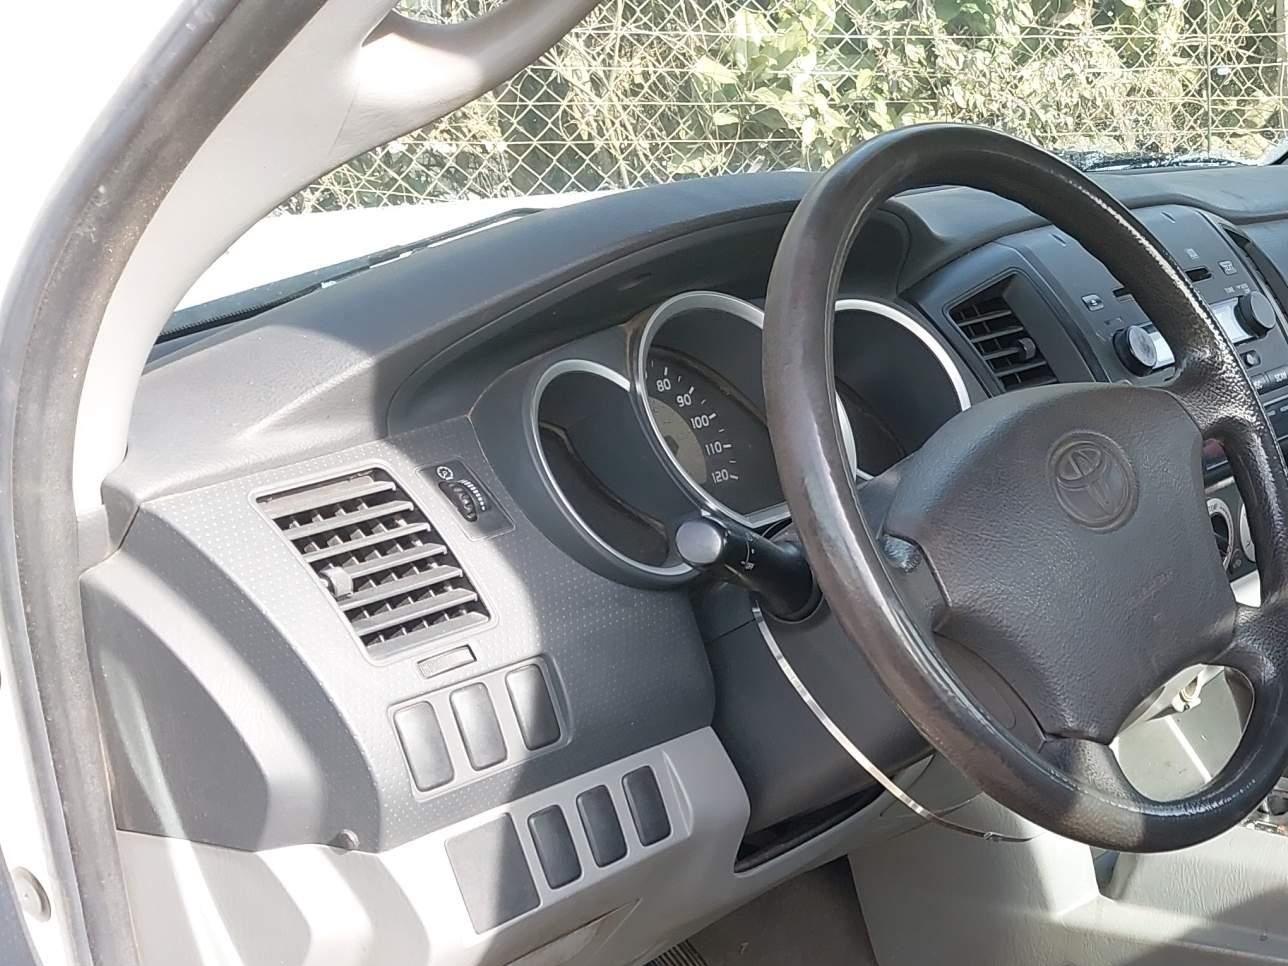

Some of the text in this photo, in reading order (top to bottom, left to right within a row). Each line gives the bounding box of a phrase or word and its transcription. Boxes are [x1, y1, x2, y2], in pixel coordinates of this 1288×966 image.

[656, 378, 671, 392] 80
[676, 393, 692, 407] 90
[690, 414, 710, 429] 100
[705, 441, 723, 456] 110
[711, 469, 729, 484] 120
